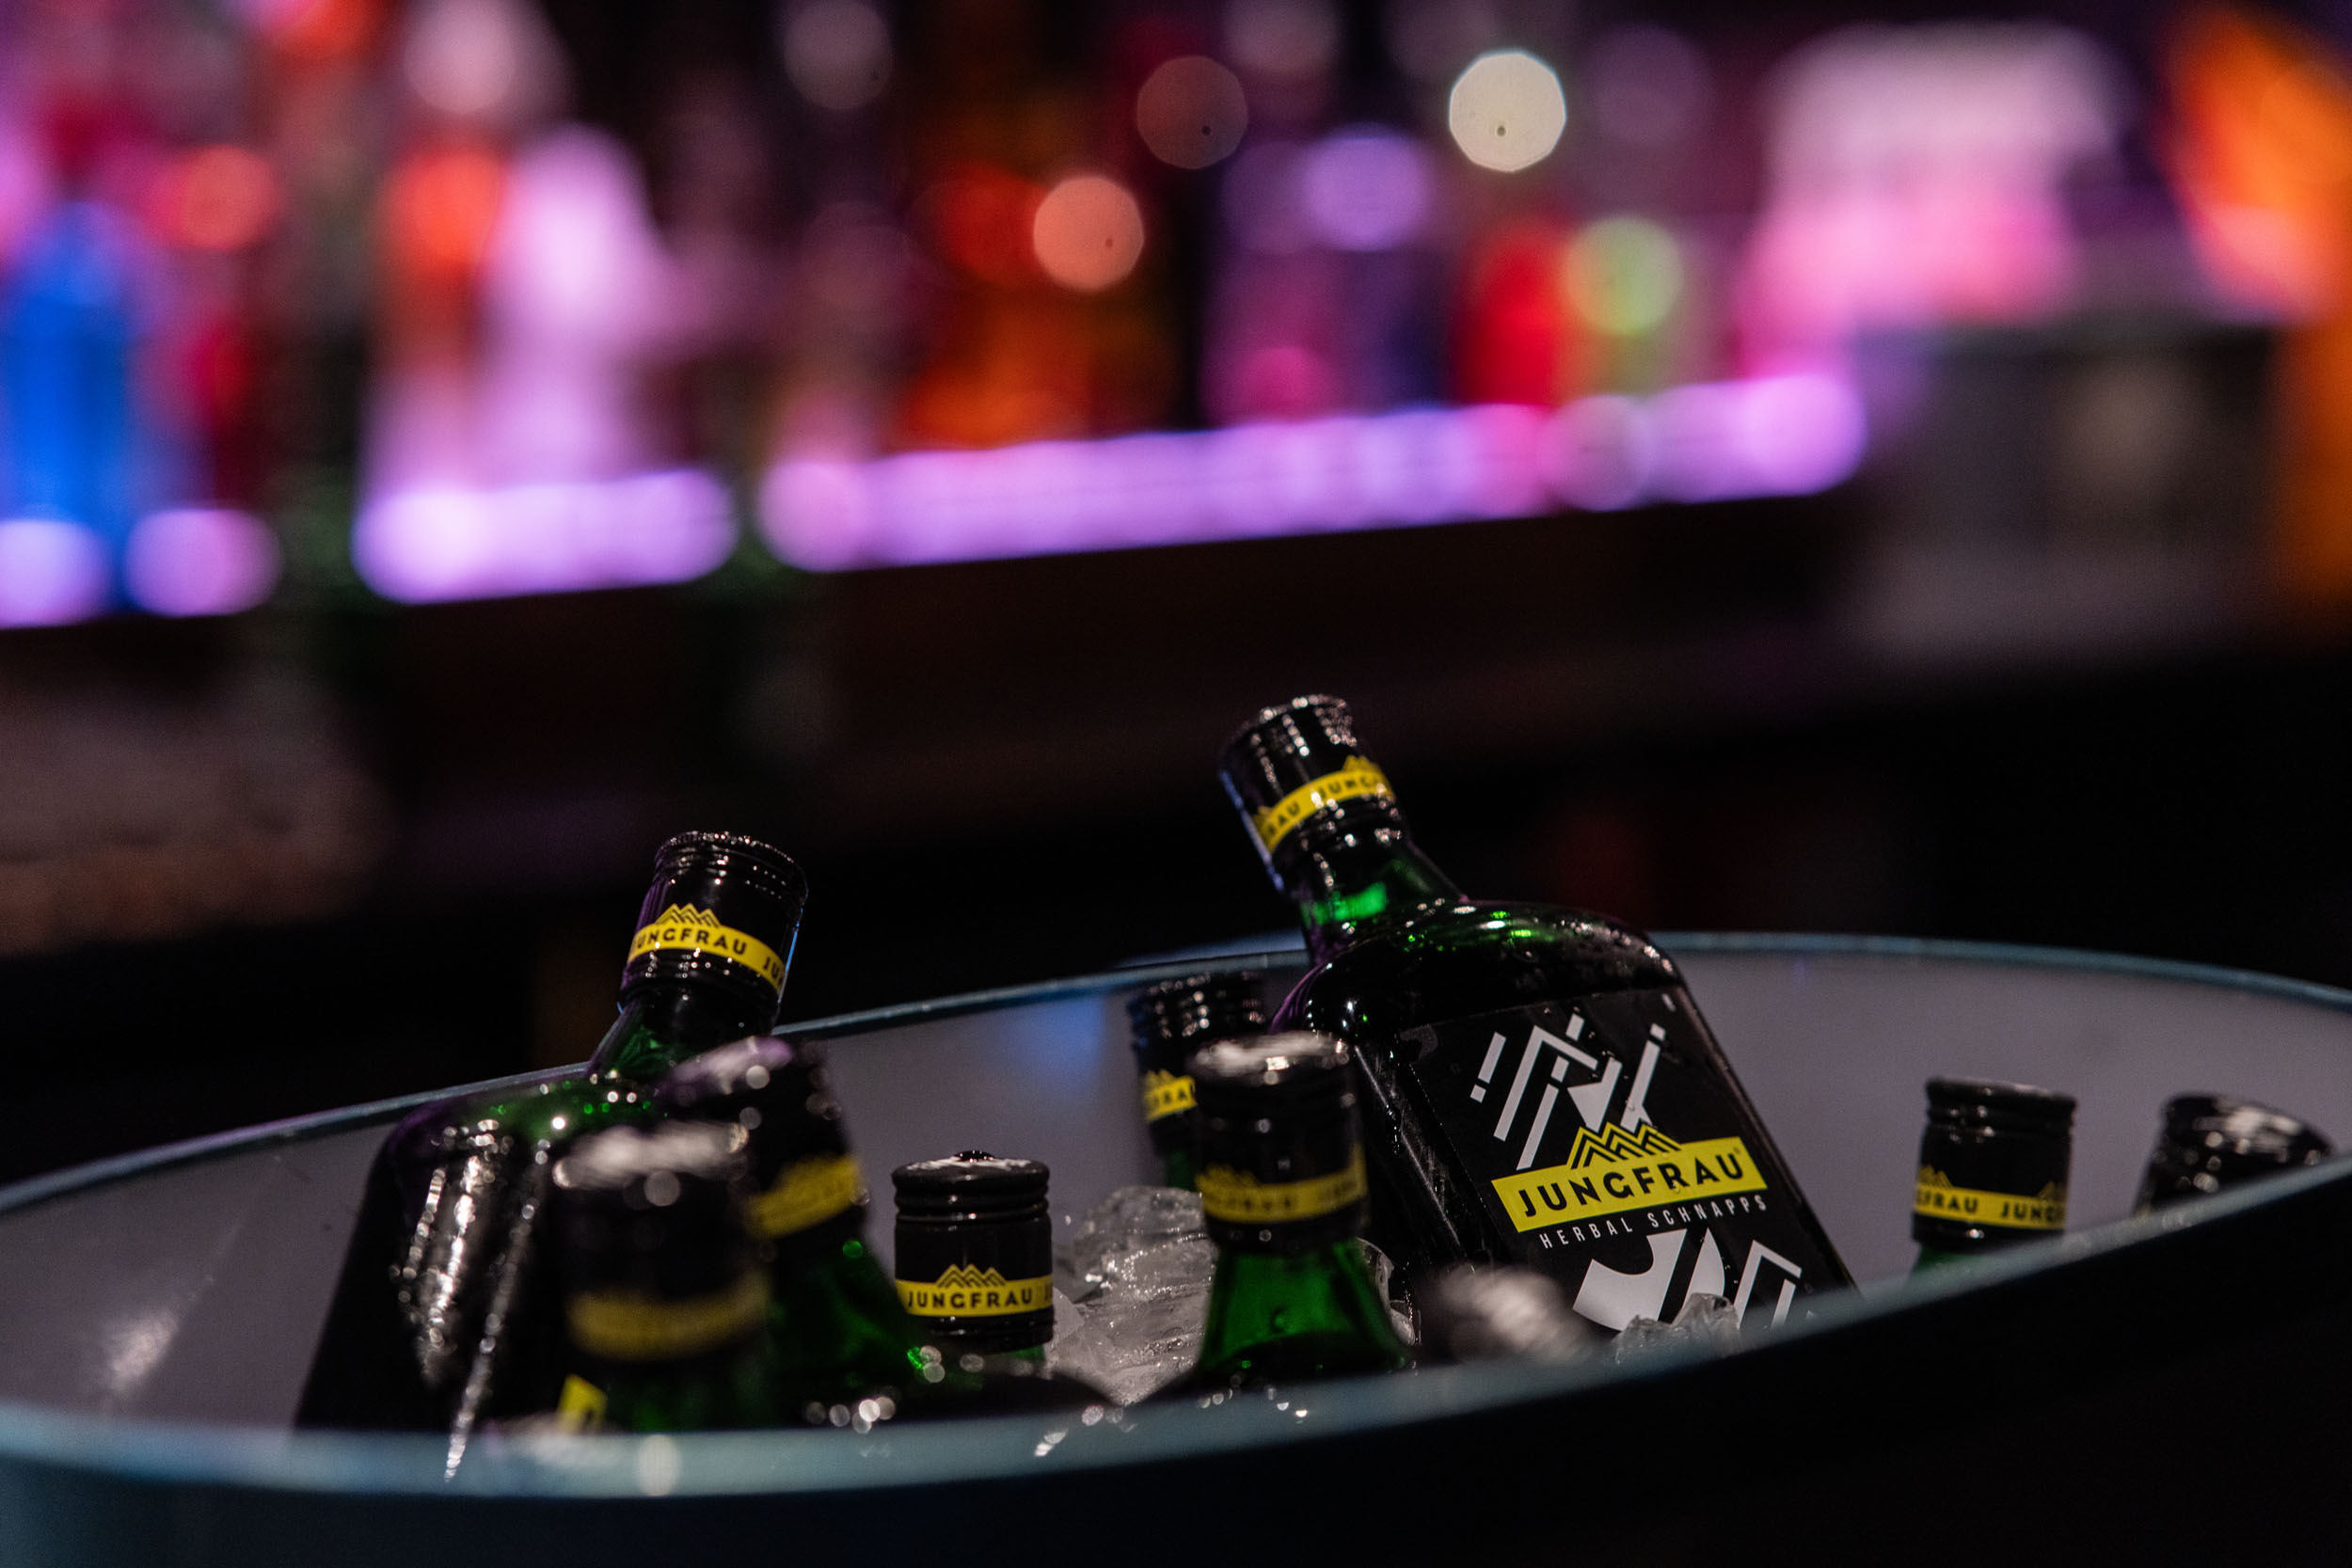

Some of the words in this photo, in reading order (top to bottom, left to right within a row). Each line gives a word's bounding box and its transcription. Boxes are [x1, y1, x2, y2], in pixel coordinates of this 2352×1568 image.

[636, 927, 747, 956] UNGFRAU
[1518, 1153, 1744, 1218] JUNGFRAU
[1539, 1217, 1632, 1248] HERBAL
[1647, 1195, 1767, 1227] SCHNAPPS
[908, 1288, 1032, 1308] JUNGFRAU
